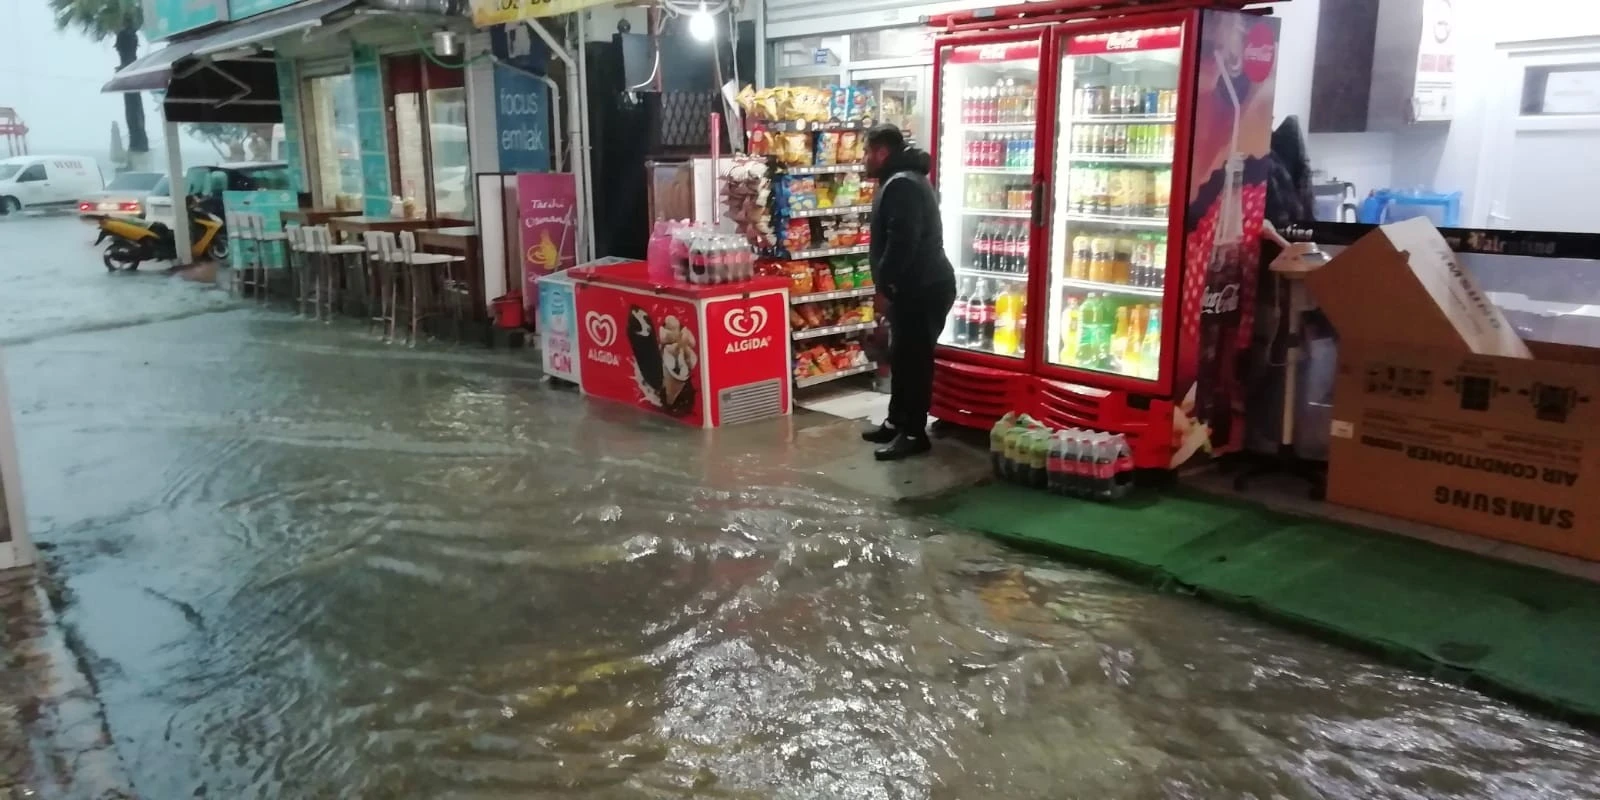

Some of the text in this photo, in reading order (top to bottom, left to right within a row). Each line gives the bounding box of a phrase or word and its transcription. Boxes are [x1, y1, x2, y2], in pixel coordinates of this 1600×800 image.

[501, 88, 539, 115] focus
[502, 124, 544, 150] emlak
[1406, 445, 1538, 480] CONDITIONER
[1542, 470, 1578, 487] AIR
[1435, 485, 1575, 530] SAMSUNG
